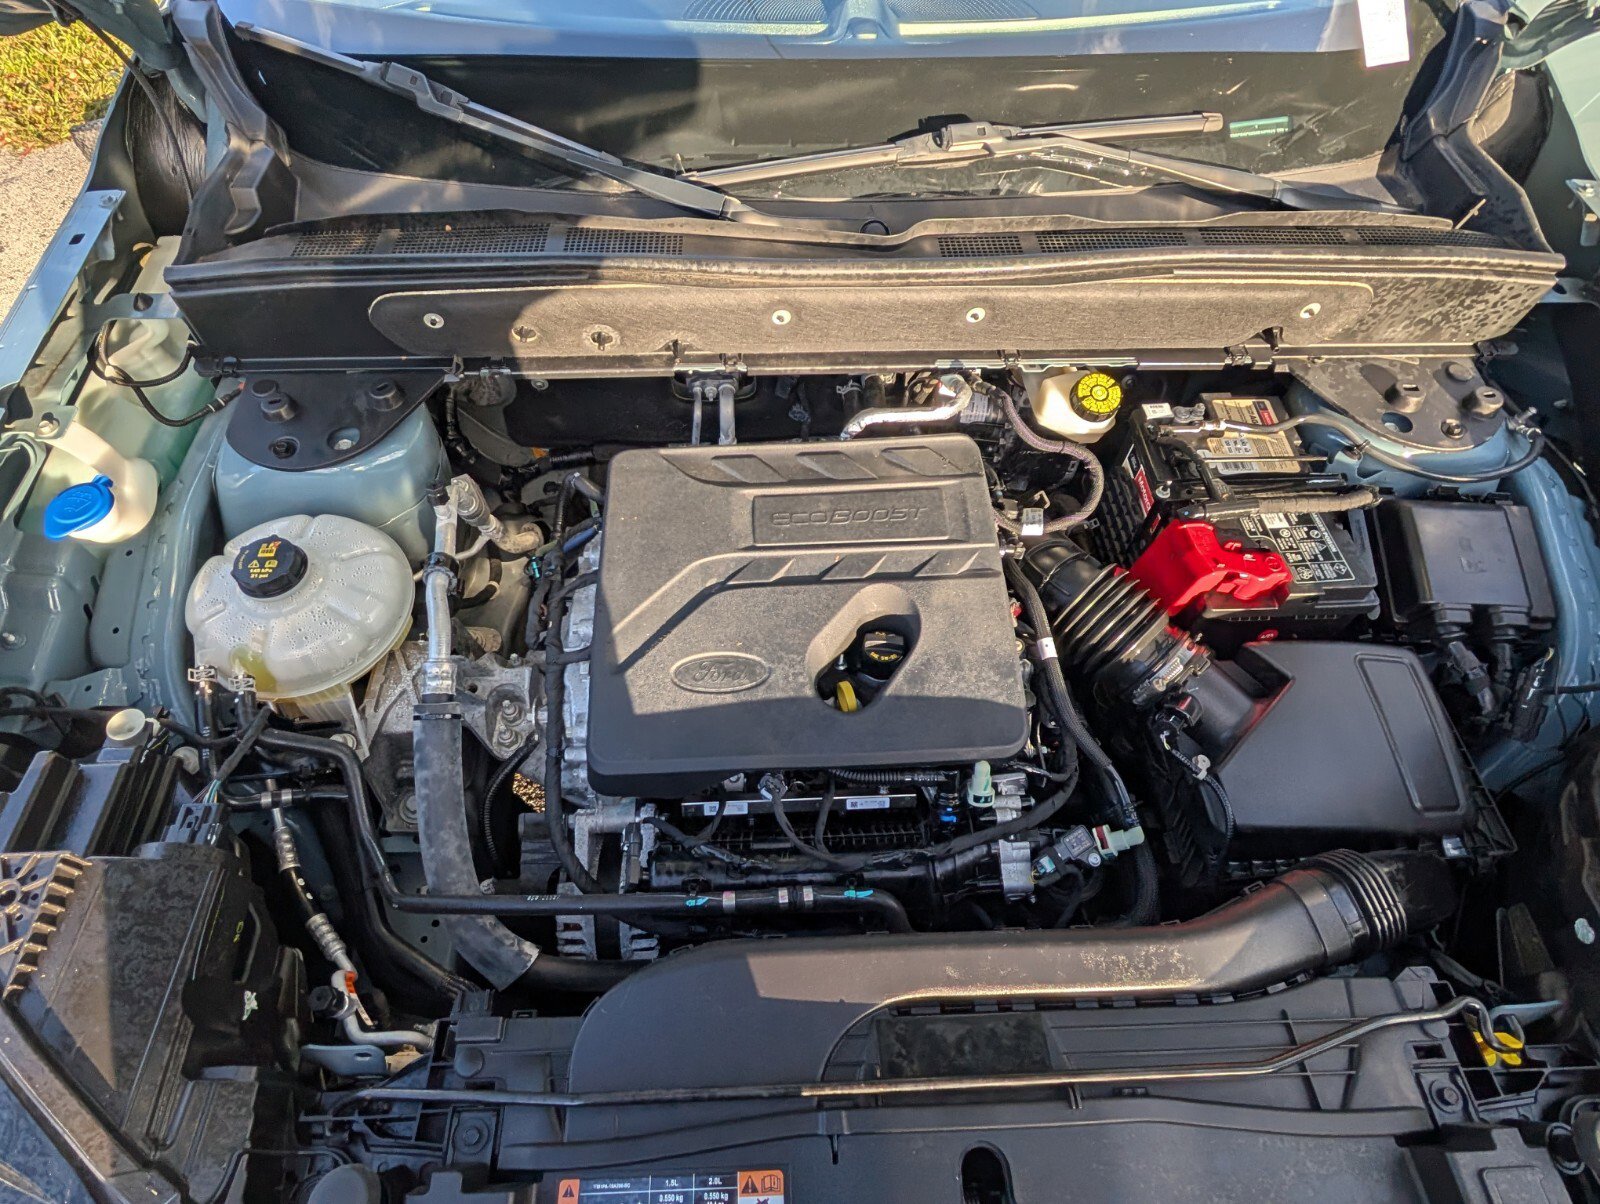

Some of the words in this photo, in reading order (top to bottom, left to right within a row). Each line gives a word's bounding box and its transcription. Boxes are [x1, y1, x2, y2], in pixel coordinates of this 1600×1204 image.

[693, 660, 748, 682] Ford
[675, 1193, 684, 1203] kg
[720, 1191, 729, 1201] kg
